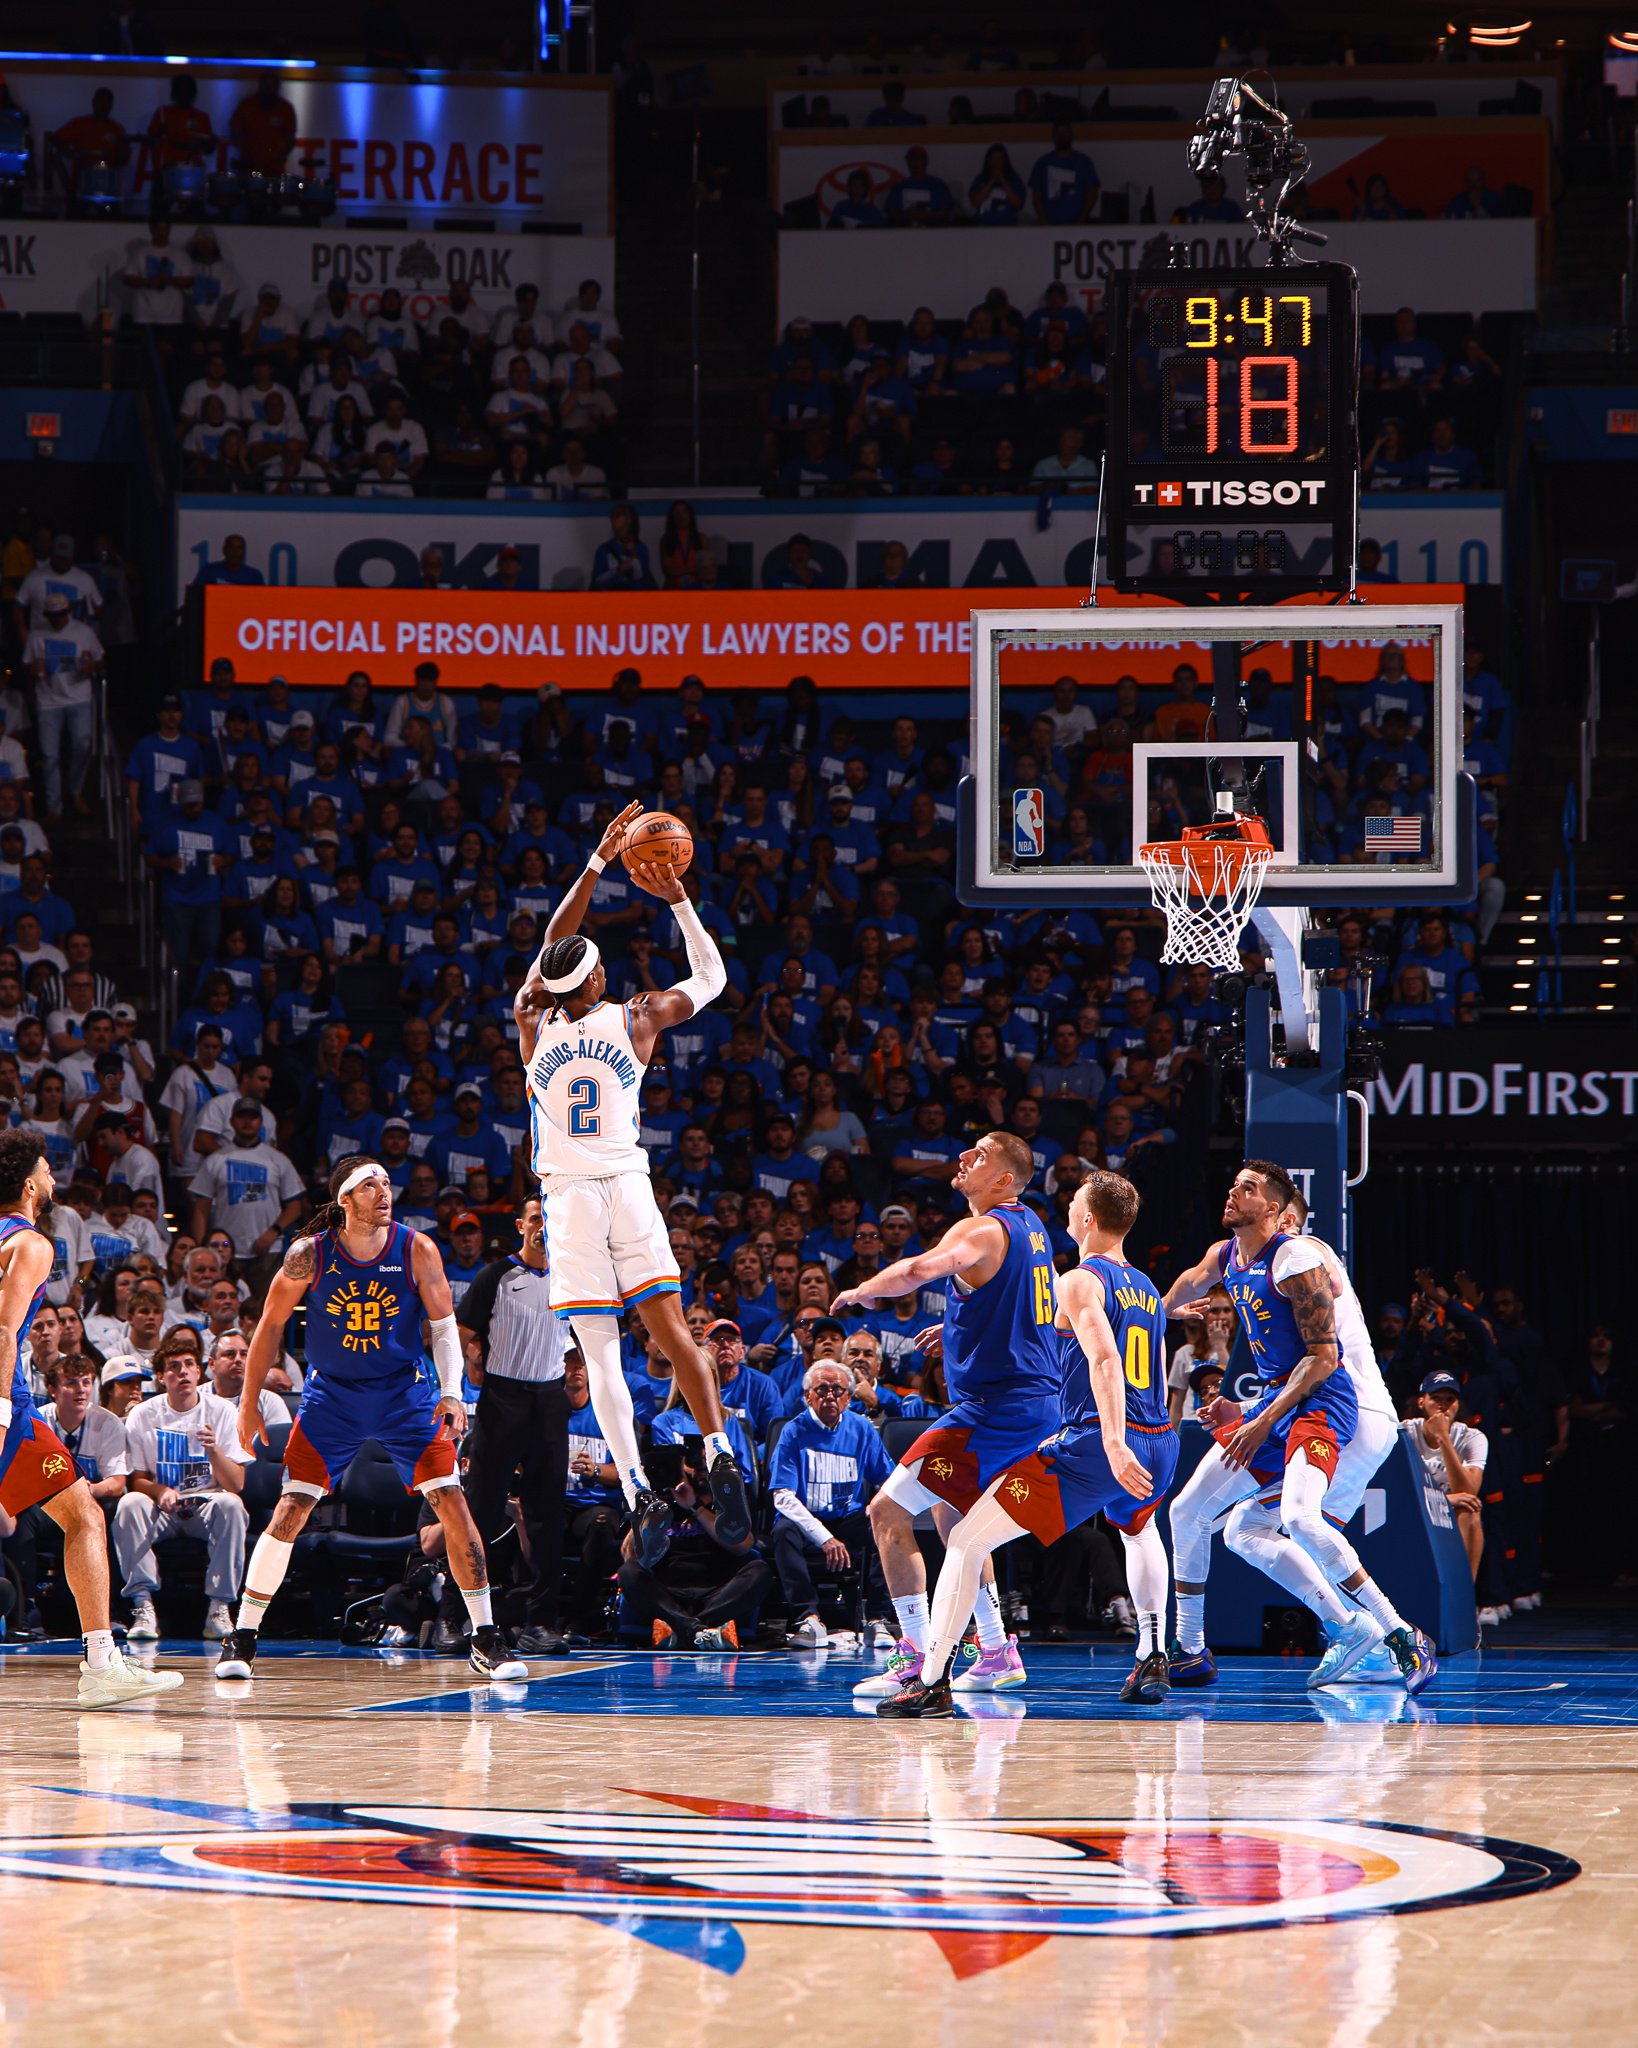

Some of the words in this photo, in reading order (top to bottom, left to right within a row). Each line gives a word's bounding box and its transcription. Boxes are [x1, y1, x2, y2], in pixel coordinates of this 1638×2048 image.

[293, 139, 544, 203] TERRACE
[312, 243, 394, 284] POST
[447, 246, 512, 288] OAK
[1054, 240, 1136, 279] POST
[1191, 238, 1257, 269] OAK
[1186, 296, 1311, 348] 9:47
[1205, 355, 1299, 454] 18
[1187, 480, 1326, 506] TISSOT
[237, 617, 386, 653] OFFICIAL
[398, 620, 565, 656] PERSONAL
[574, 622, 692, 656] INJURY
[702, 621, 851, 655] LAWYERS
[860, 621, 904, 655] OF
[914, 620, 971, 654] THE
[1018, 841, 1033, 852] NBA
[534, 1038, 637, 1091] GILGEOUS-ALEXANDER
[567, 1075, 601, 1137] 2
[326, 1280, 361, 1316] MILE
[366, 1280, 400, 1318] HIGH
[1032, 1264, 1053, 1325] 15
[1114, 1286, 1159, 1316] BRAUN
[346, 1301, 380, 1332] 32
[342, 1334, 381, 1354] CITY
[1124, 1323, 1152, 1391] 0
